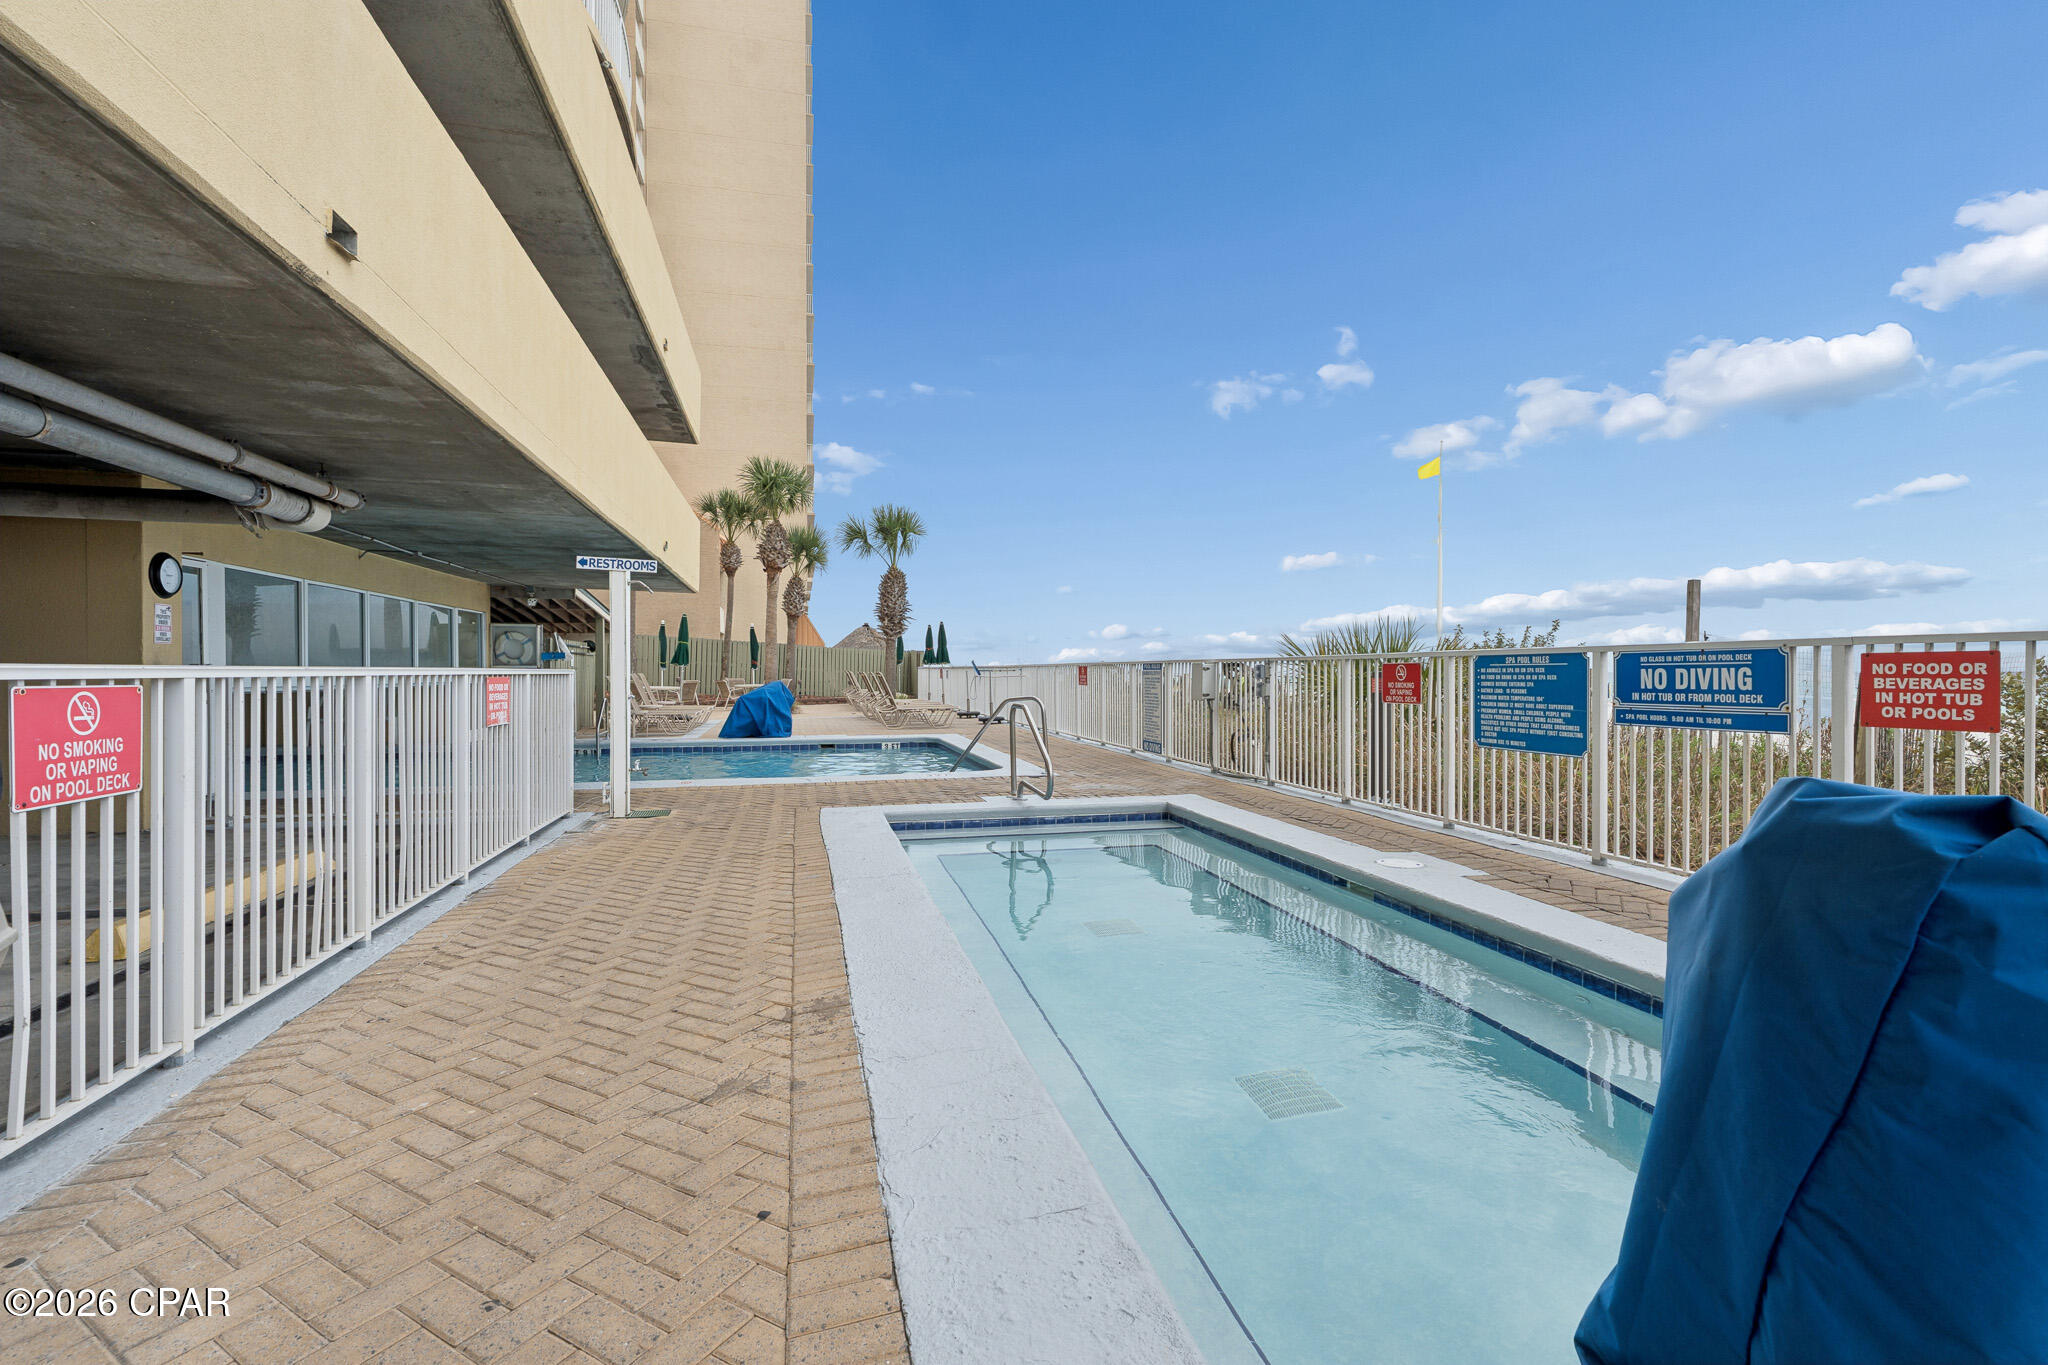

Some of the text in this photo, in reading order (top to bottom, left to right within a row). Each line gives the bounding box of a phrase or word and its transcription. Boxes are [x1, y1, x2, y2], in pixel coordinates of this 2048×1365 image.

[588, 558, 656, 571] RESTROOMS
[1872, 663, 1988, 675] NO FOOD OR
[1640, 667, 1752, 690] NO DIVING
[1874, 678, 1985, 690] BEVERAGES
[1658, 693, 1672, 701] TUB
[1688, 694, 1712, 702] FROM
[1714, 694, 1736, 703] POOL
[1739, 694, 1763, 704] DECK
[1875, 692, 1983, 706] IN HOT TUB
[1882, 706, 1975, 721] OR POOLS
[38, 737, 124, 760] NO SMOKING
[46, 756, 118, 780] OR VAPING
[30, 772, 130, 803] ON POOL DECK
